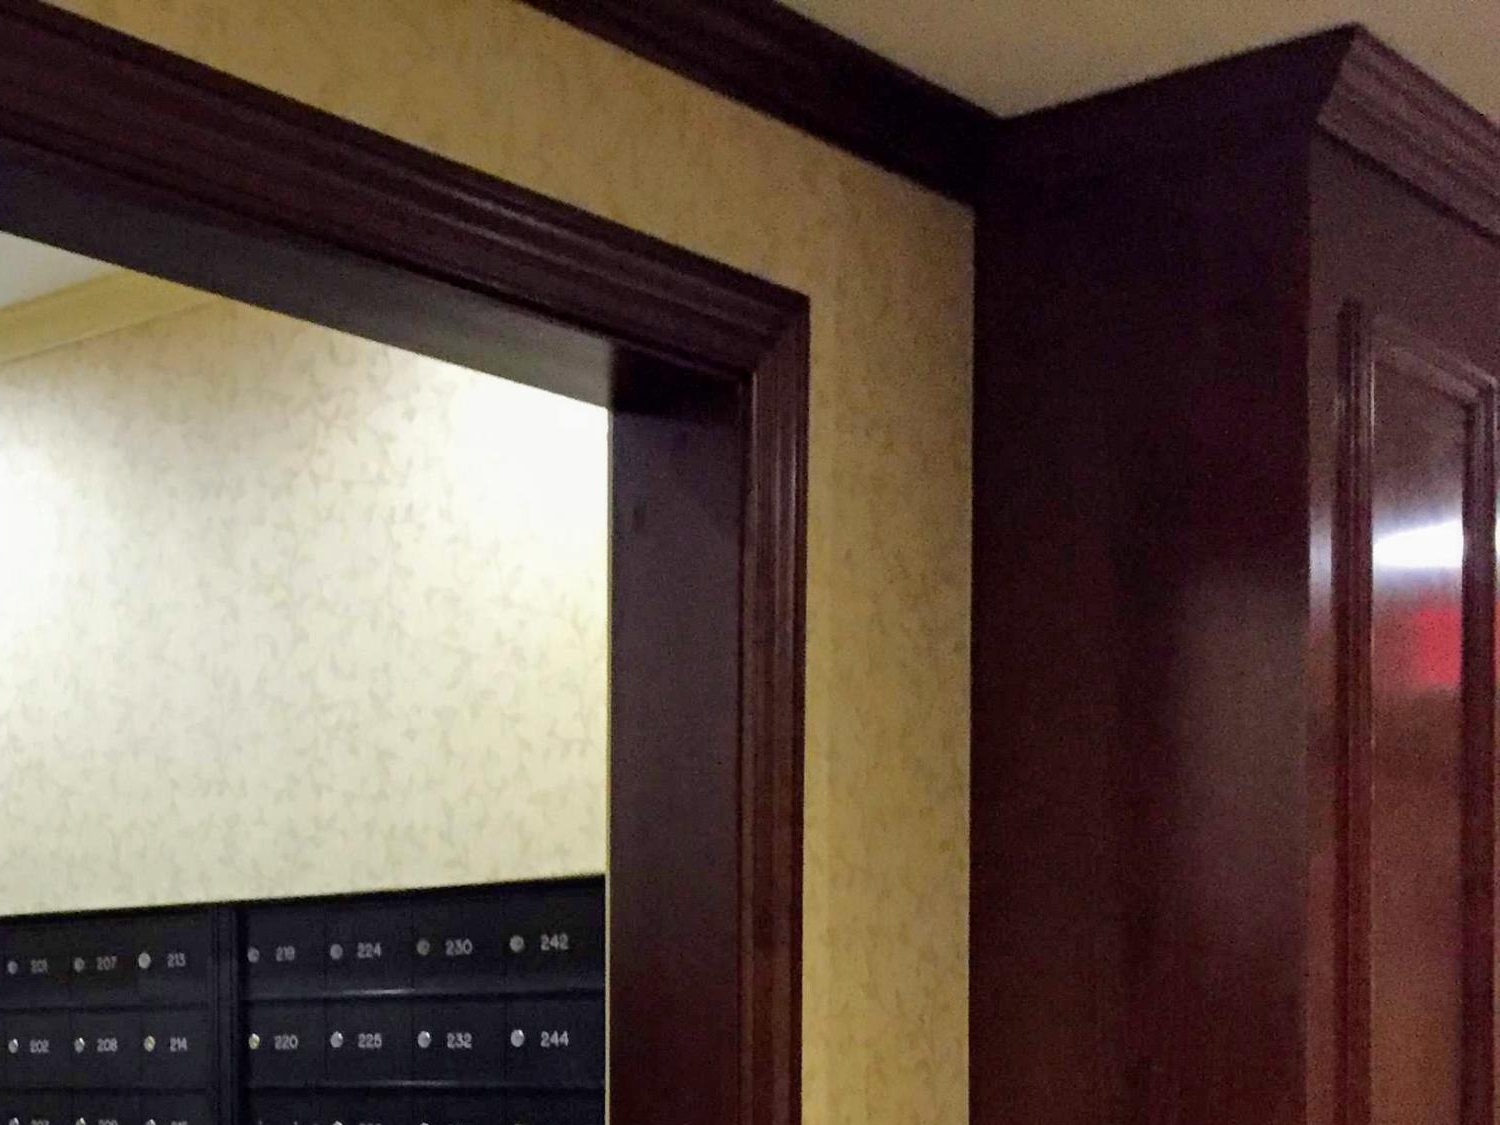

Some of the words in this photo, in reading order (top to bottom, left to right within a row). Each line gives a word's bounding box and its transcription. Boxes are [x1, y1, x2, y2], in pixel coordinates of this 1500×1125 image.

[445, 938, 474, 957] 230
[540, 932, 569, 951] 242
[356, 942, 382, 959] 224
[273, 1033, 299, 1050] 220
[446, 1032, 473, 1049] 232
[540, 1030, 570, 1048] 244
